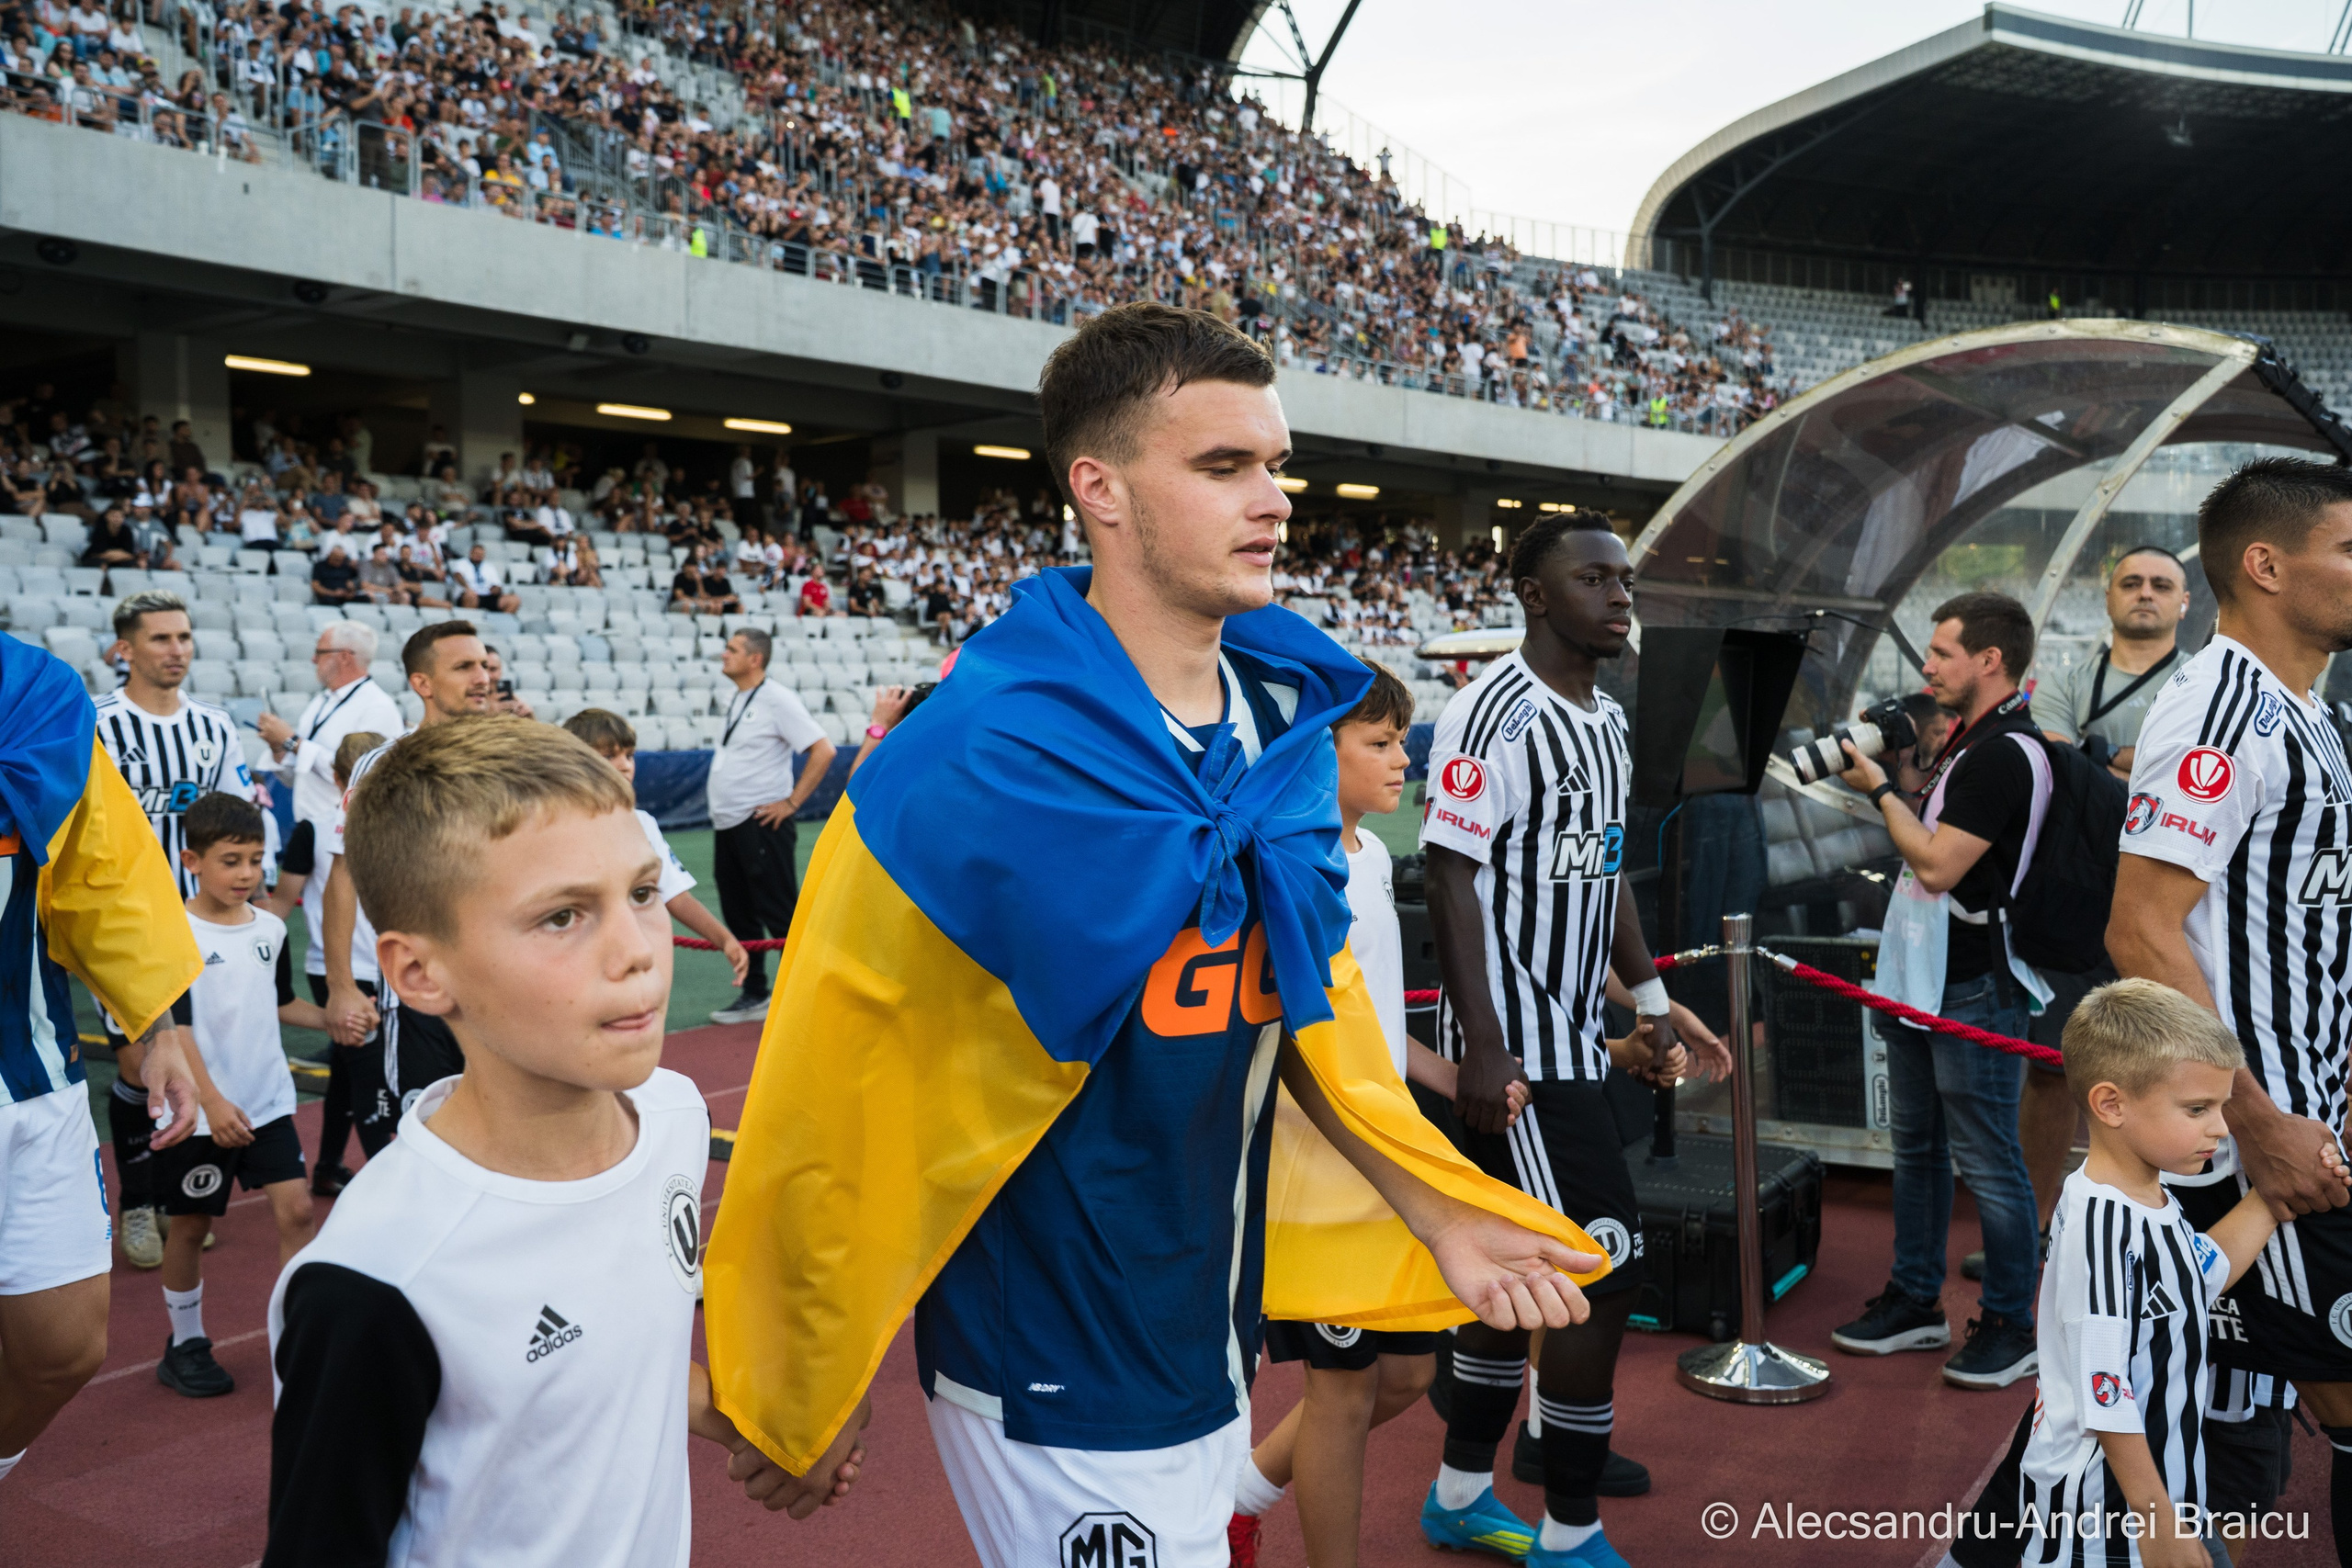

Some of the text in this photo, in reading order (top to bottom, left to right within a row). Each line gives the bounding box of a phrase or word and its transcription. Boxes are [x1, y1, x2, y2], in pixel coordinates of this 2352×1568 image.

[200, 748, 210, 761] U
[1437, 808, 1490, 840] IRUM
[257, 945, 271, 962] U
[194, 1173, 211, 1190] U
[673, 1202, 698, 1266] U
[1593, 1231, 1618, 1257] U
[526, 1325, 582, 1363] adidas
[1071, 1523, 1146, 1568] MG
